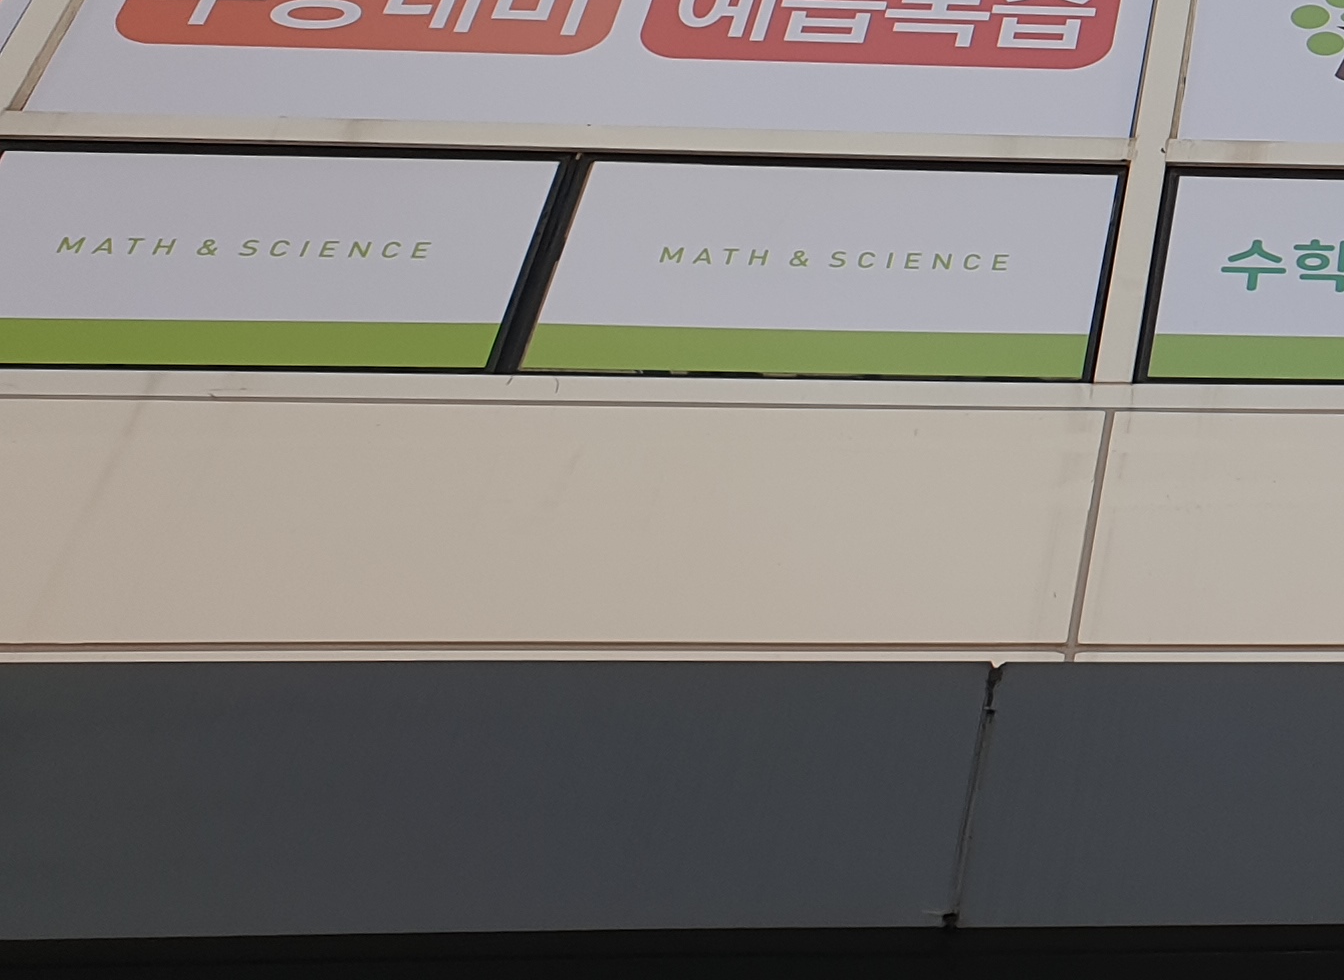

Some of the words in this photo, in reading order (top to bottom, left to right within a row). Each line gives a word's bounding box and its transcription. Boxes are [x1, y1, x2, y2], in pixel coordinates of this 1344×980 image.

[56, 236, 177, 256] MATH
[196, 238, 218, 256] &
[238, 239, 432, 259] SCIENCE
[659, 246, 769, 267] MATH
[788, 249, 809, 268] &
[828, 250, 1010, 272] SCIENCE
